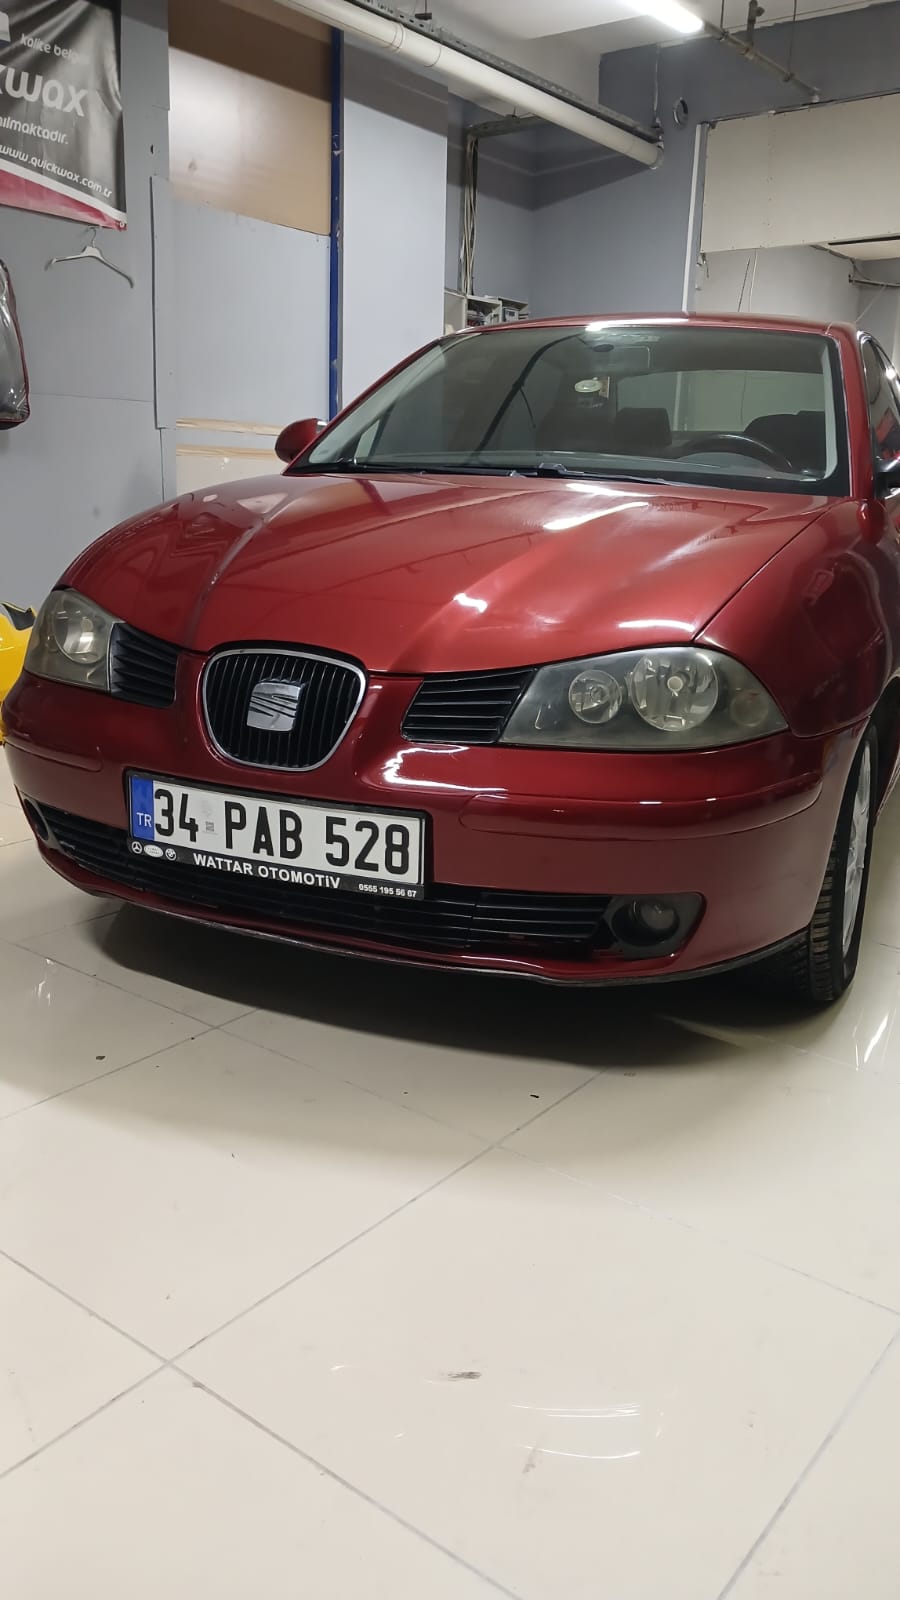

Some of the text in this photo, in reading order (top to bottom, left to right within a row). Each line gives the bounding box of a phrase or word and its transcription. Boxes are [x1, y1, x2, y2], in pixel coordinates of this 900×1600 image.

[21, 33, 51, 53] kalite
[136, 812, 152, 828] TR
[154, 788, 410, 875] 34 PAB 528
[193, 852, 253, 876] WATTAR
